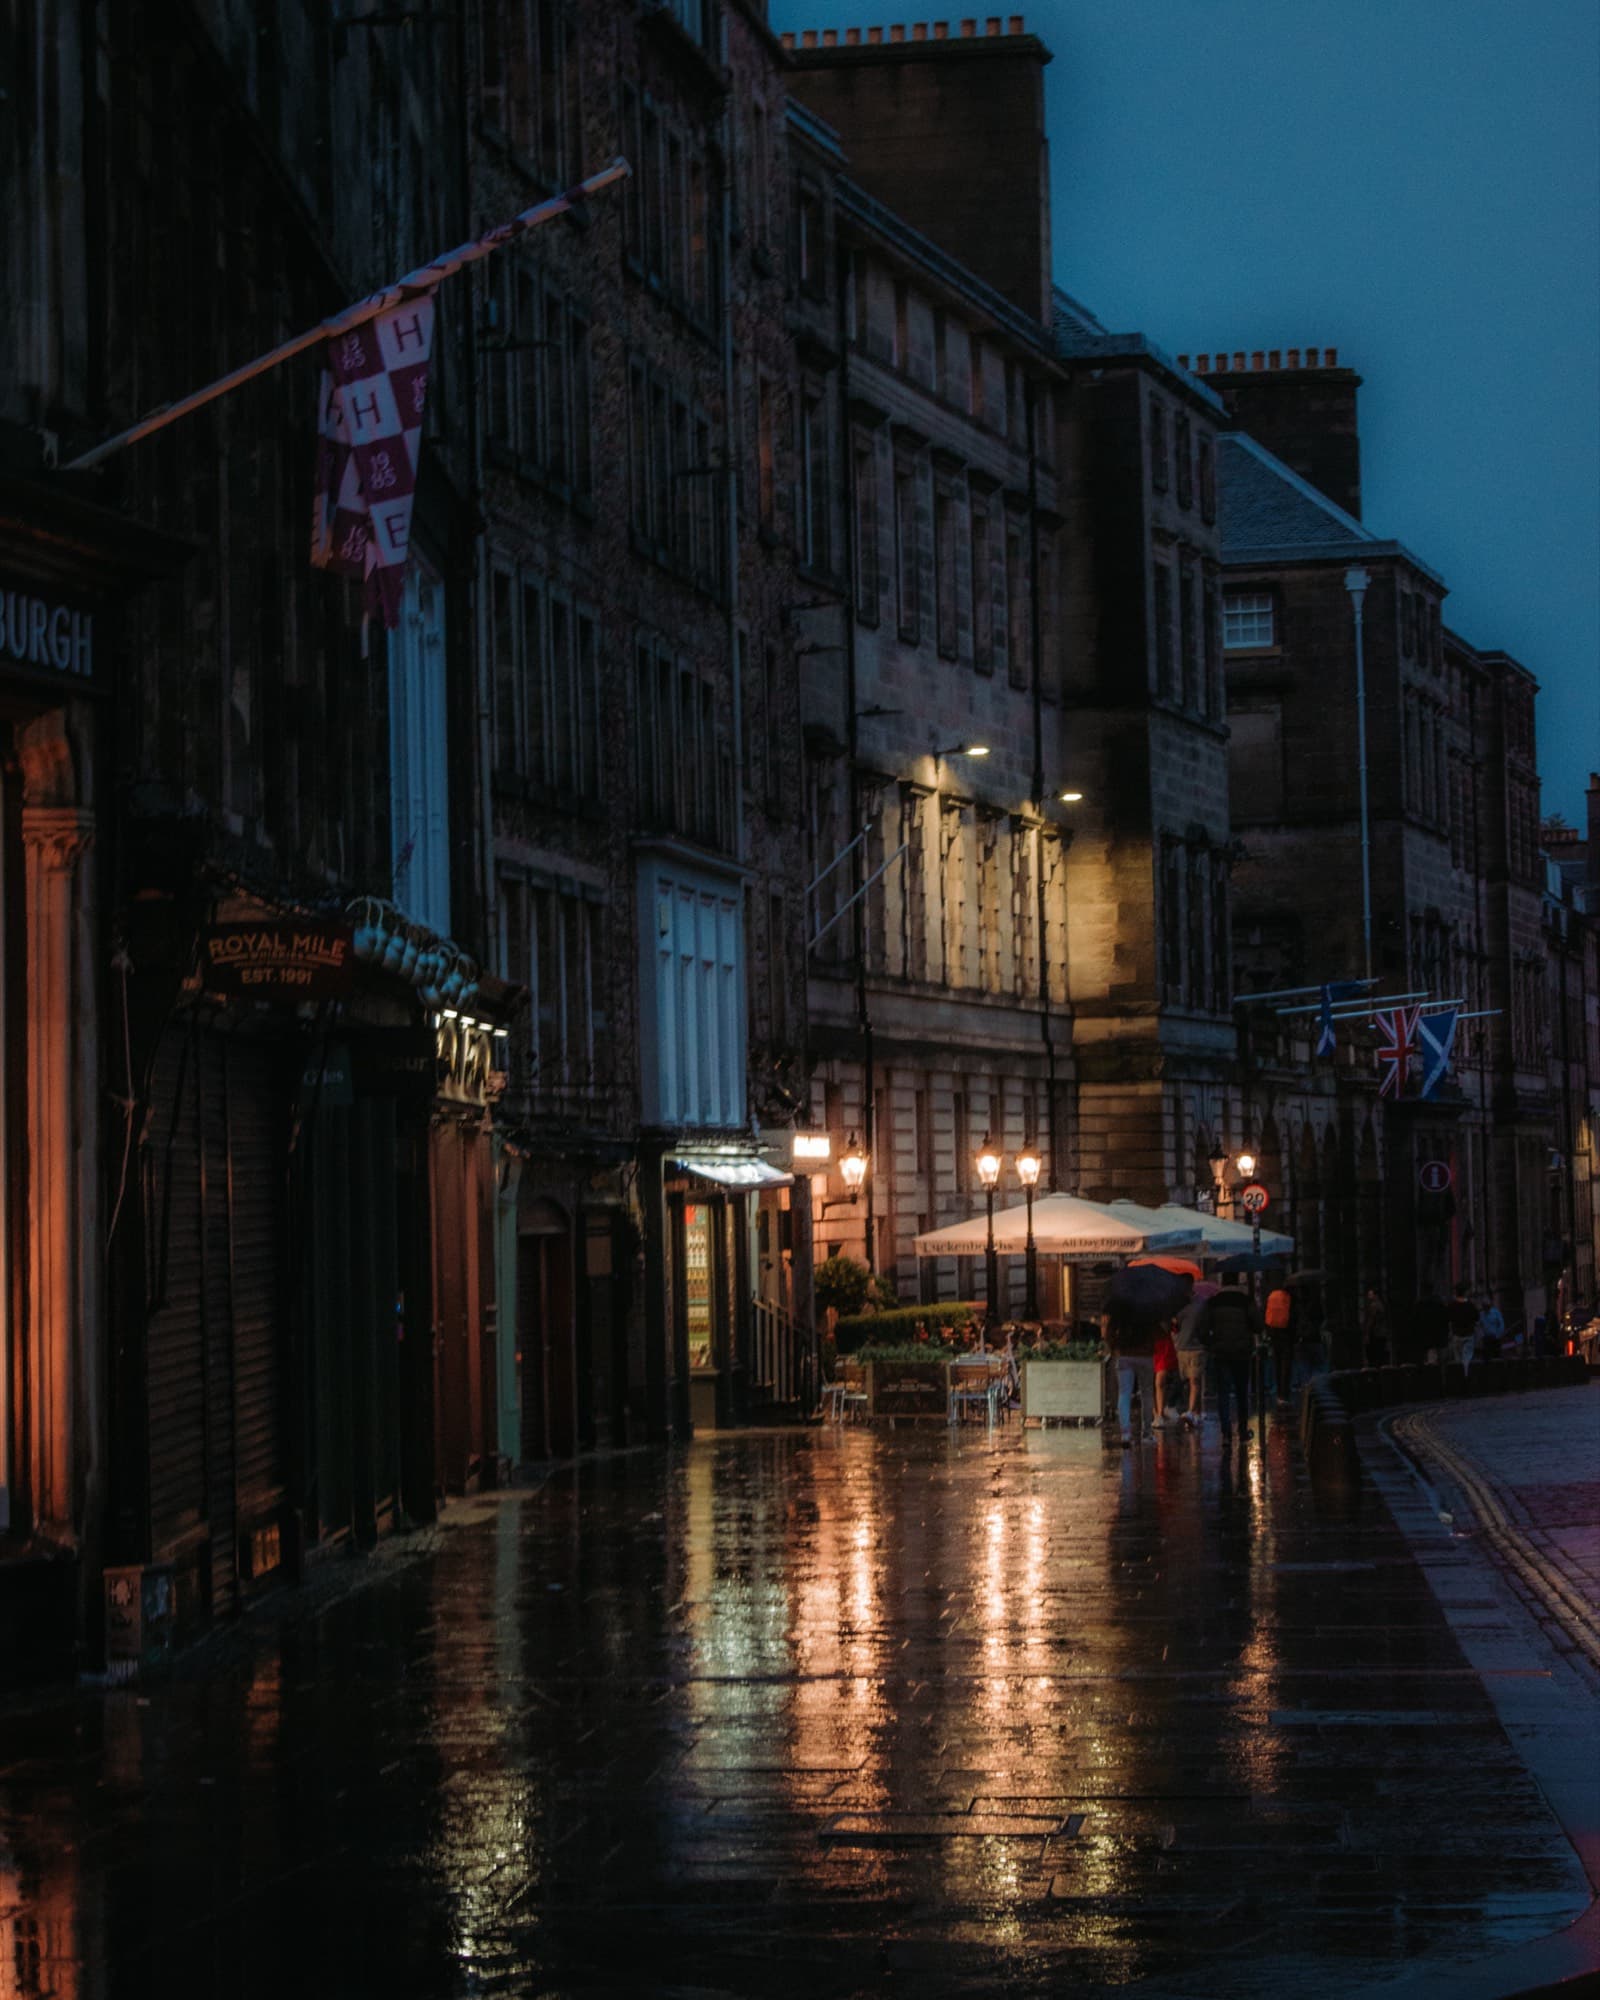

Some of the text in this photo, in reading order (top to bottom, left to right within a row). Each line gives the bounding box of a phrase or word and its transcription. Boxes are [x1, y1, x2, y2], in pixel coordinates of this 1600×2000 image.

[208, 931, 347, 960] ROYAL MILE
[1245, 1192, 1265, 1205] 20
